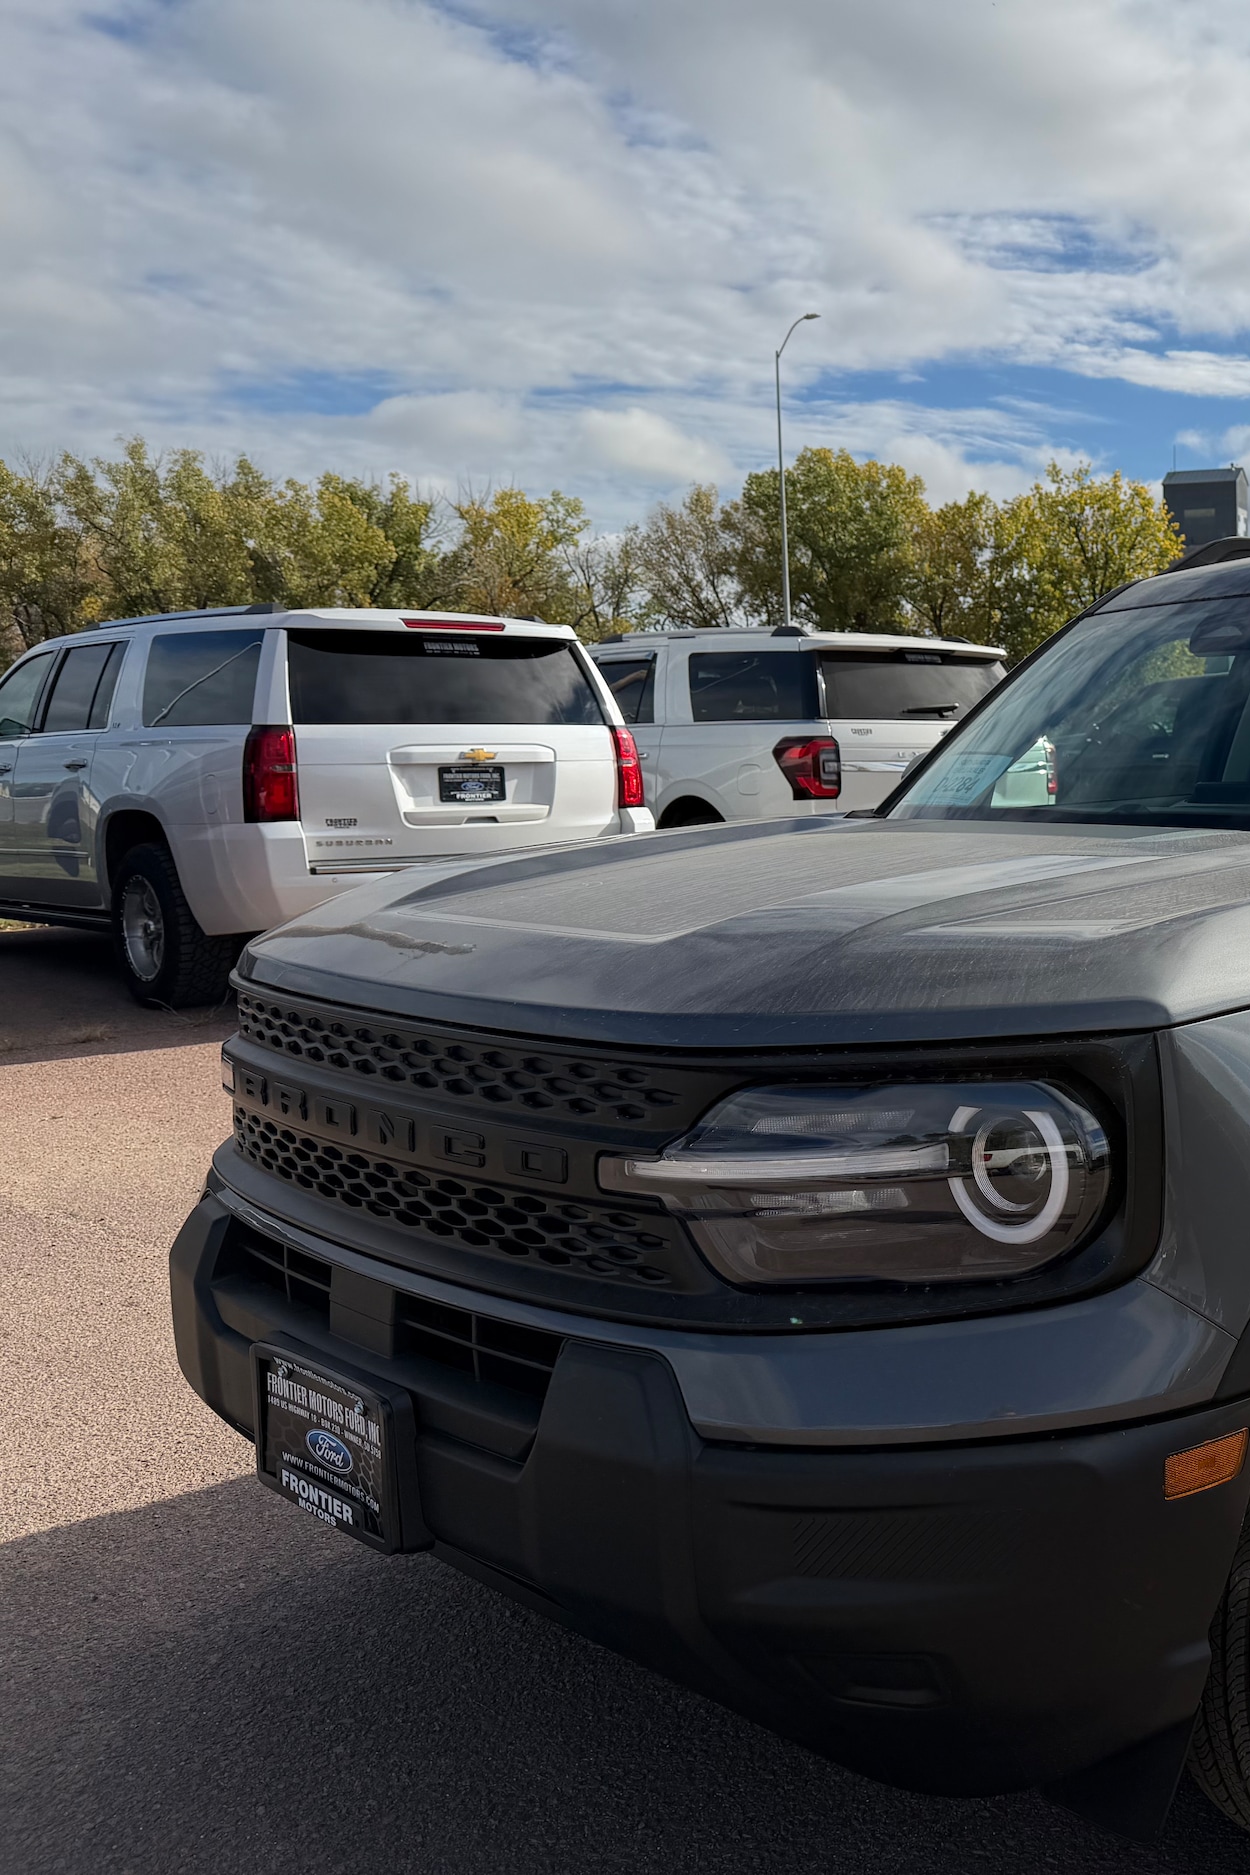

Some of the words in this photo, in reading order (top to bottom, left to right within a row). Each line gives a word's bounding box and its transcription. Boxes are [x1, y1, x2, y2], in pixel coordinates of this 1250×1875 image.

[316, 839, 393, 847] SUBURBAN
[240, 1068, 568, 1184] BRONCO
[267, 1371, 309, 1408] FRONTIER
[308, 1389, 345, 1425] MOTORS
[280, 1399, 288, 1411] US
[287, 1402, 311, 1421] HIGHWAY
[315, 1434, 345, 1468] Ford
[281, 1451, 380, 1514] WWW.FRONTIERMOTORS.COM
[281, 1468, 354, 1526] FRONTIER
[298, 1496, 338, 1527] MOTORS
